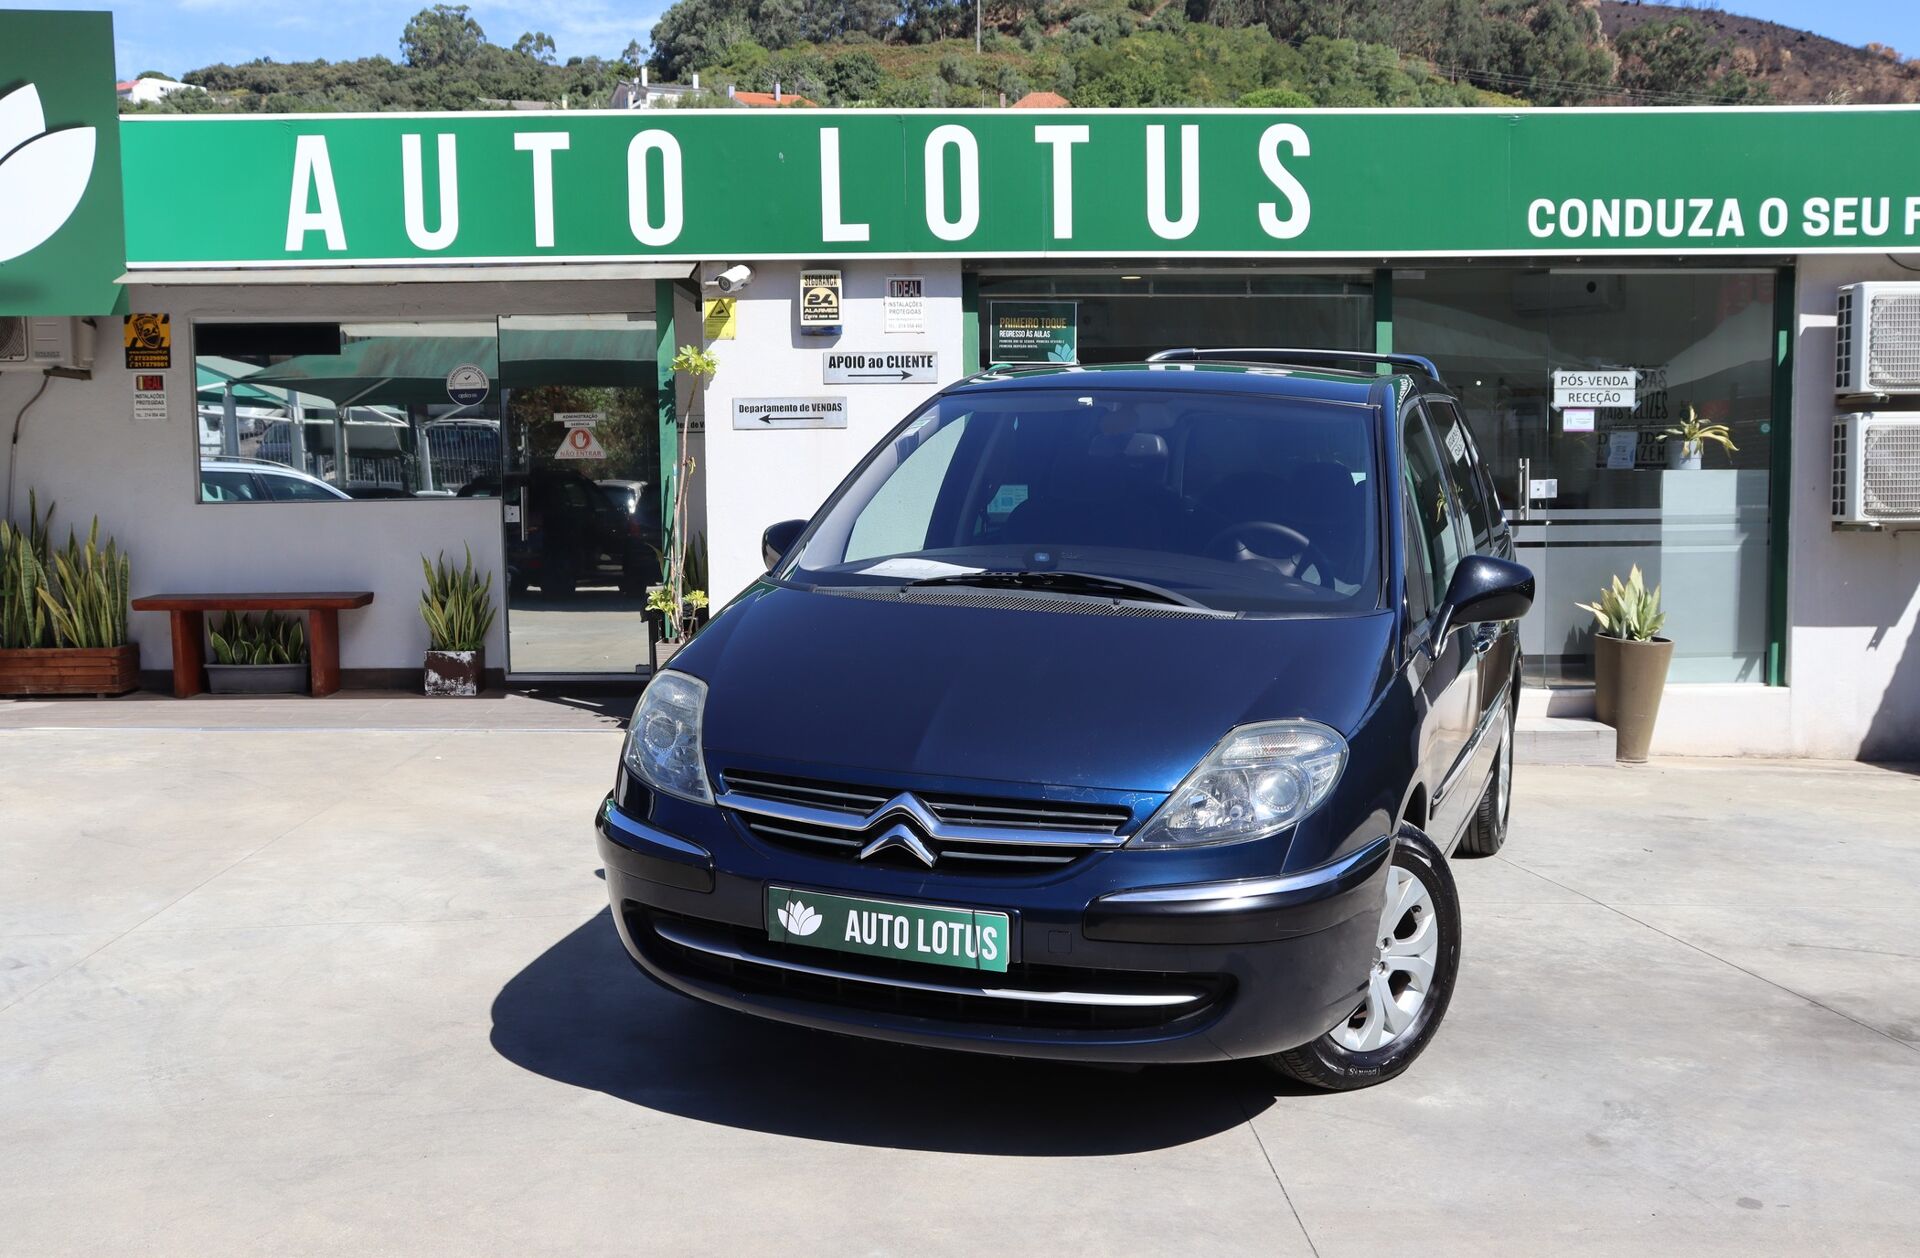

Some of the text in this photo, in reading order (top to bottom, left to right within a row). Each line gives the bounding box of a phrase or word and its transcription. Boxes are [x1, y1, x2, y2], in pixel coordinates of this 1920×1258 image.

[285, 123, 1311, 251] AUTO LOTUS
[1528, 198, 1745, 238] CONDUZA
[1759, 197, 1788, 237] O
[1802, 196, 1890, 236] SEU
[894, 281, 920, 297] IDEAL
[807, 293, 834, 305] 24
[999, 317, 1067, 329] PRIMEIRO TOQUE
[999, 330, 1026, 338] REGRESSO
[1033, 330, 1051, 338] AULAS
[828, 355, 933, 369] APOIO ao CLIENTE
[1560, 374, 1629, 386] PÓS-VENDA
[1568, 391, 1621, 405] RECEÇÃO
[738, 402, 842, 414] Departamento de VENDAS
[844, 909, 998, 961] AUTO LOTUS
